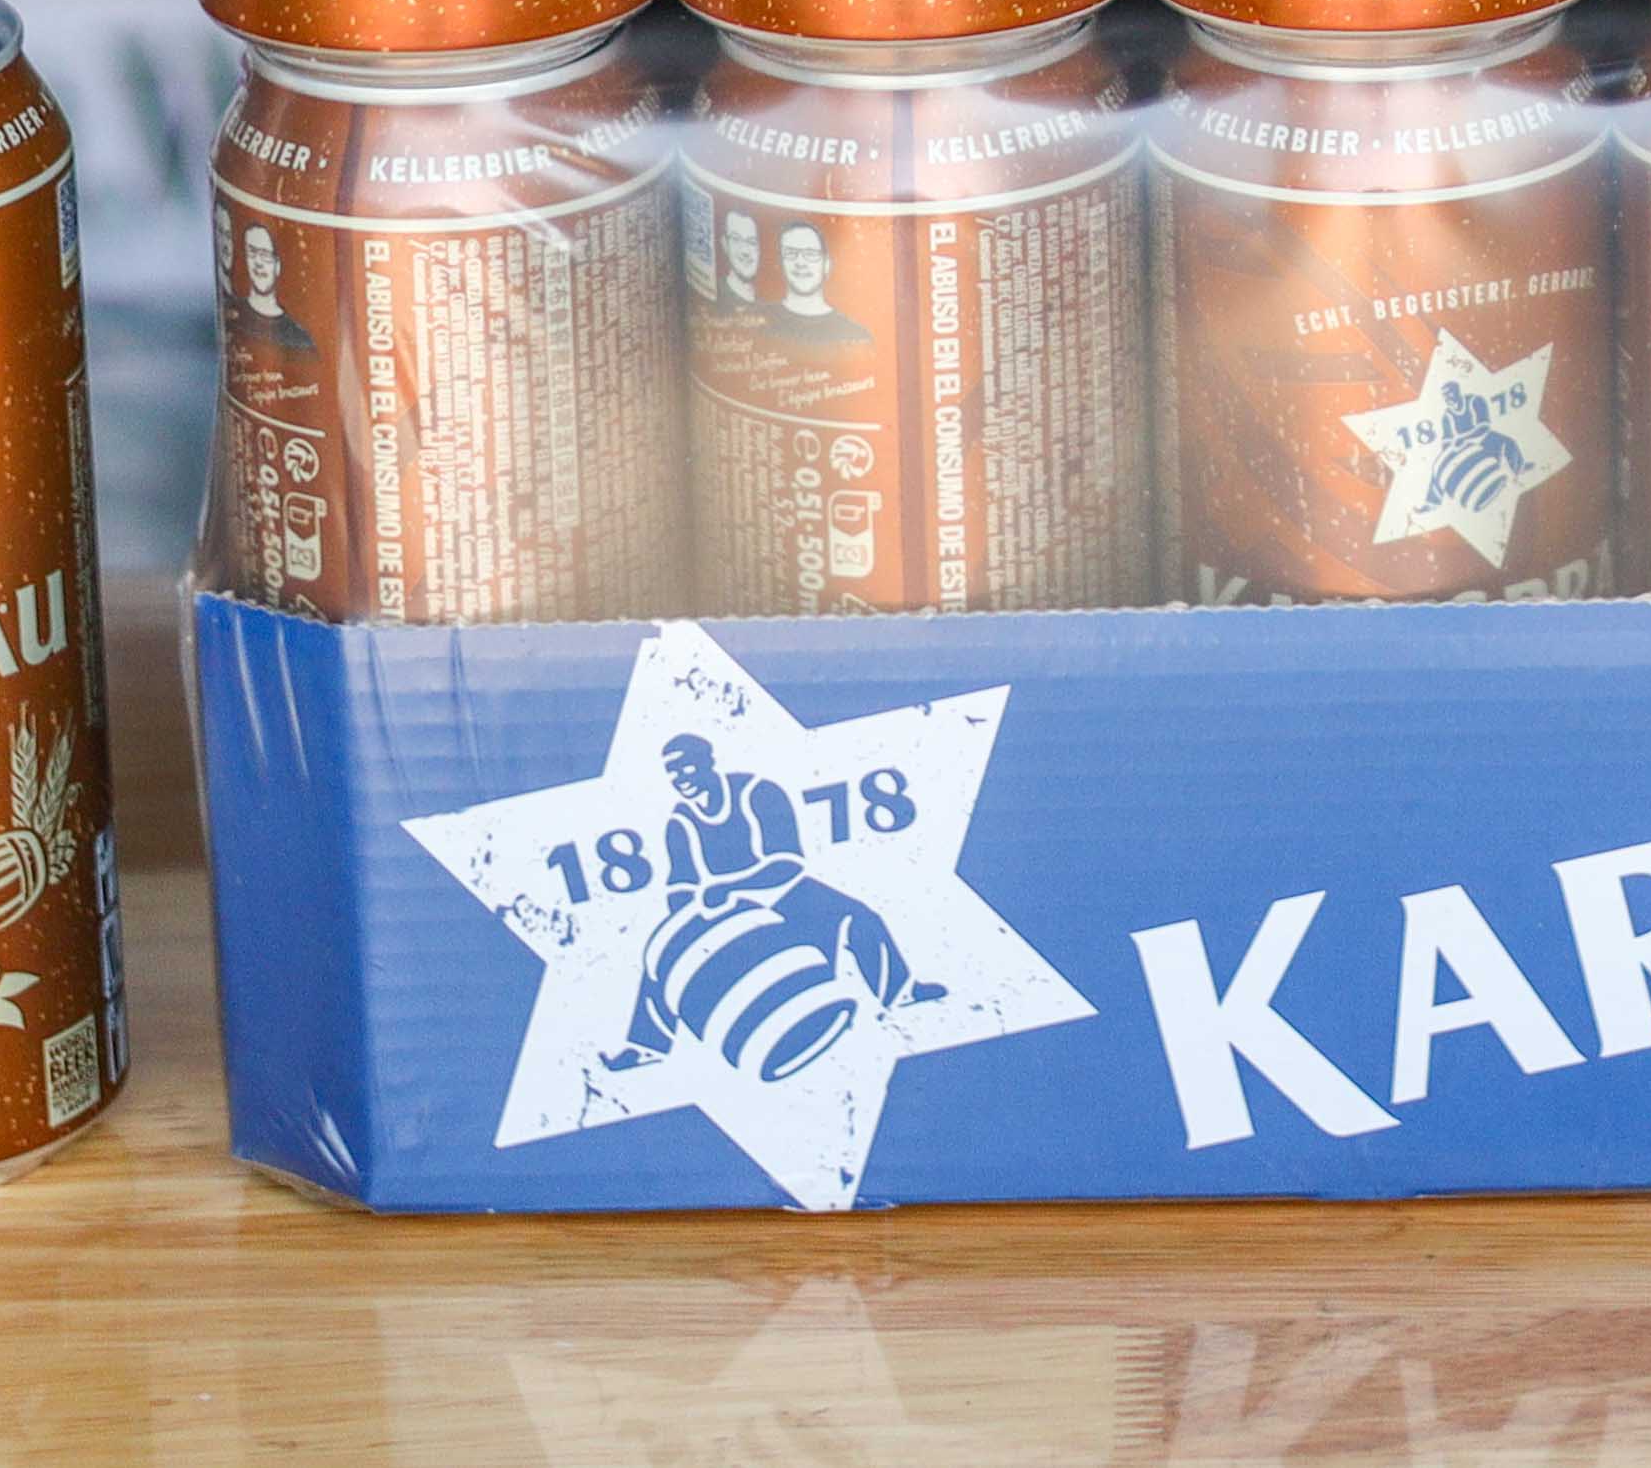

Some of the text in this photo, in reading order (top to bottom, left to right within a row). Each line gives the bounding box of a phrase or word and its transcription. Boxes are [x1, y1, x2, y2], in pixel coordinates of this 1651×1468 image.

[1394, 103, 1554, 155] KELLERBIER
[370, 146, 550, 183] KELLERBIER
[929, 223, 956, 250] EL
[931, 256, 958, 333] ABUSO
[933, 339, 959, 368] EN
[934, 375, 961, 401] EL
[935, 407, 963, 519] CONSUMO
[938, 526, 965, 554] DE
[546, 765, 918, 906] 18 78
